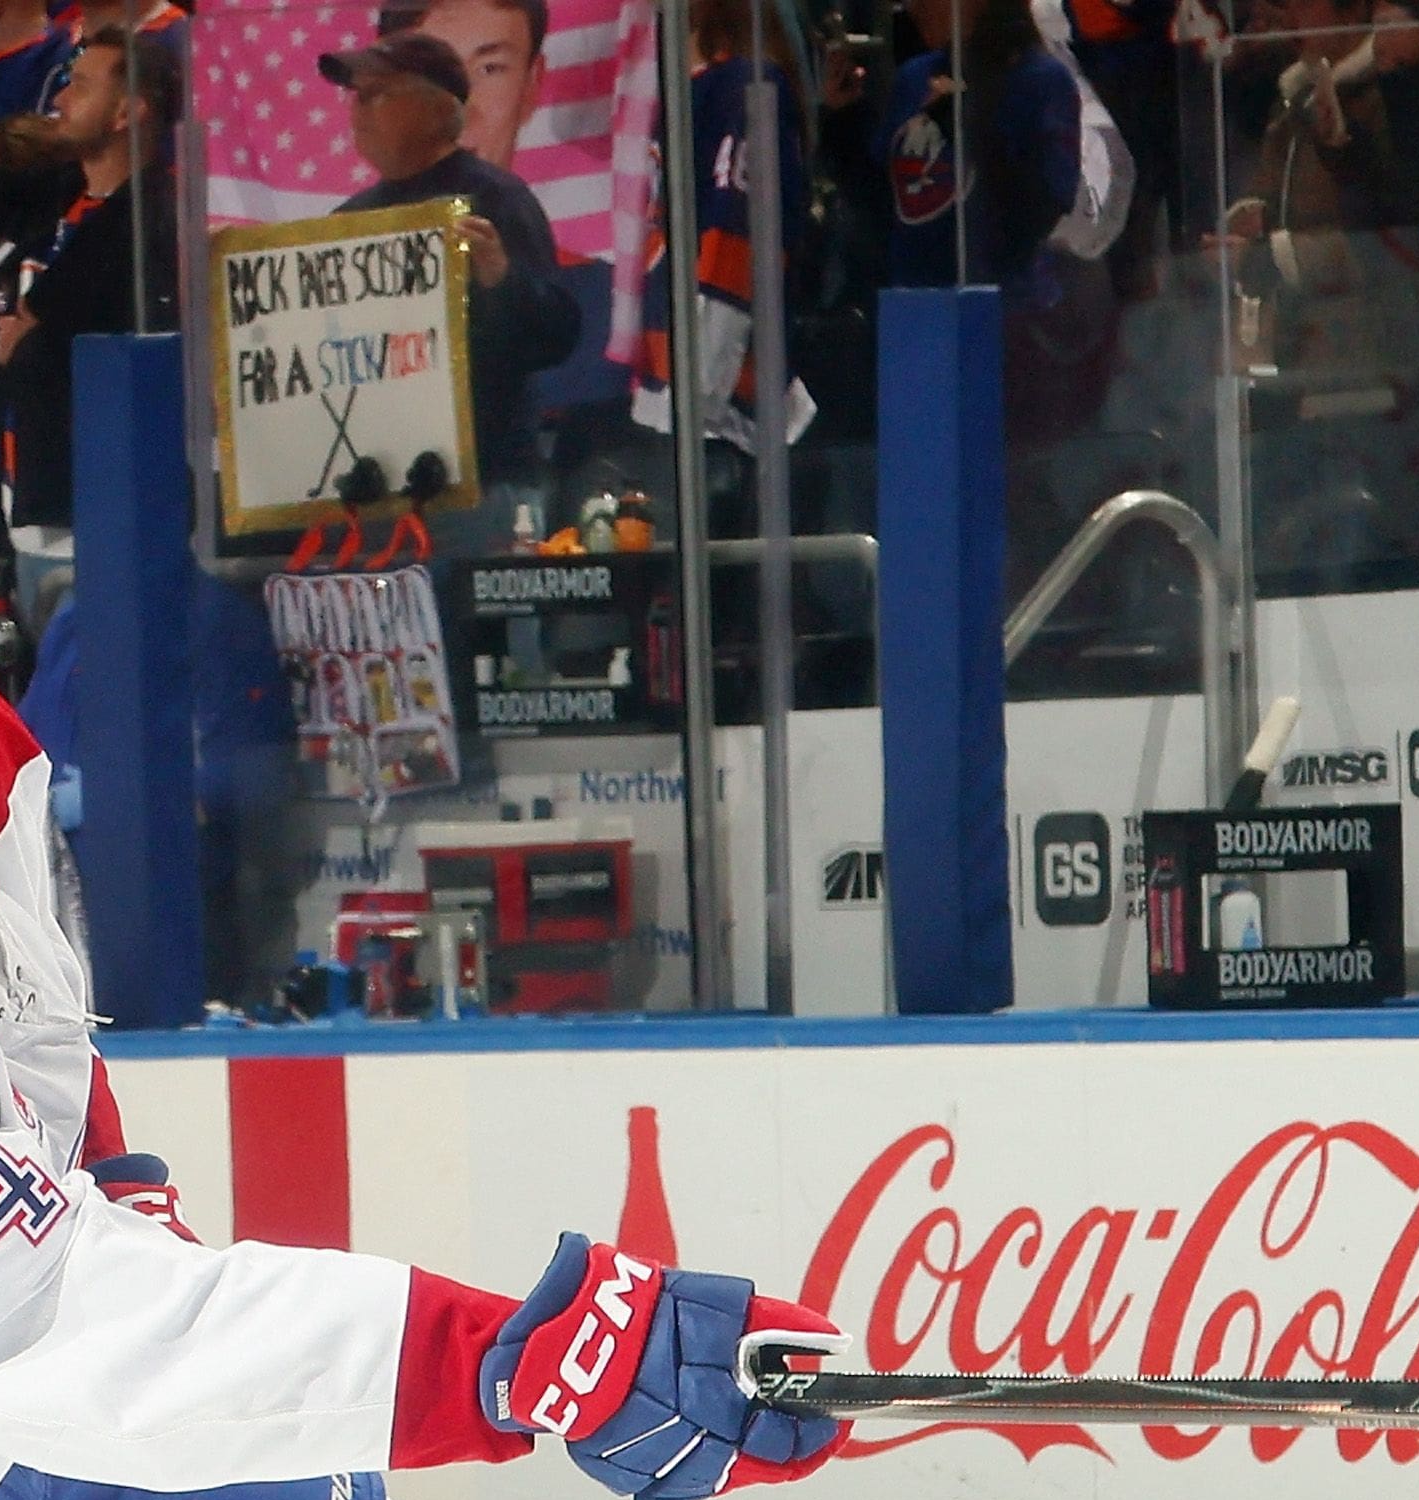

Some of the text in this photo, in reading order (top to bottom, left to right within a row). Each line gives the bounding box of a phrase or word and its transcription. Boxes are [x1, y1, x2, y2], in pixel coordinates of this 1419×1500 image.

[285, 342, 314, 397] A
[473, 567, 612, 600] BODYARMOR
[478, 690, 615, 722] BODYARMOR
[1307, 750, 1389, 787] MSG
[1214, 818, 1372, 855] BODYARMOR
[1044, 841, 1101, 899] GS
[1218, 949, 1375, 987] BODYARMOR
[528, 1252, 654, 1437] CCM
